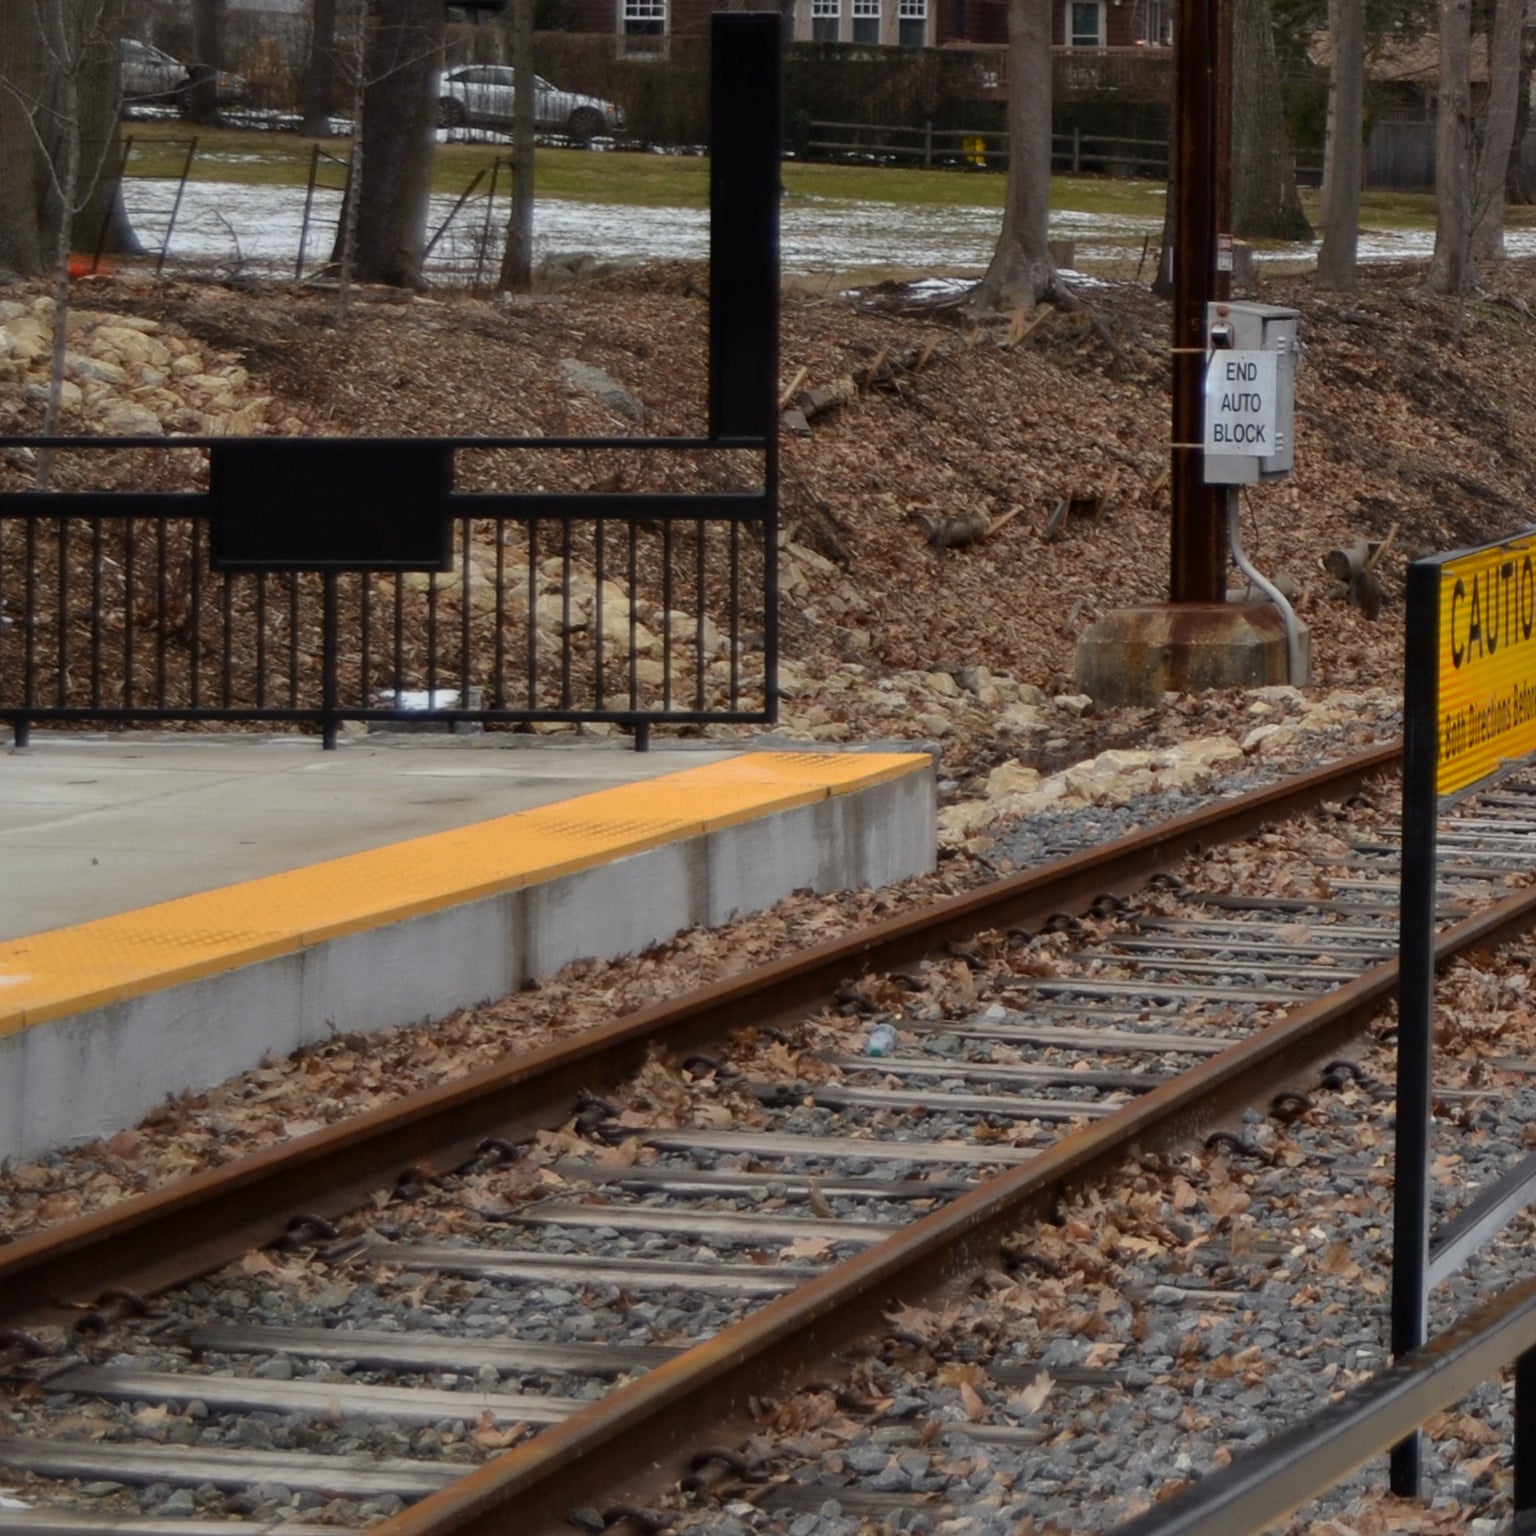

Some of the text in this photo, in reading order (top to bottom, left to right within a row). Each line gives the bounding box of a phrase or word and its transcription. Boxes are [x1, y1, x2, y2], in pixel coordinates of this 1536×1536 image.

[1226, 362, 1257, 381] END
[1221, 393, 1262, 413] AUTO
[1213, 423, 1266, 443] BLOCK
[1468, 693, 1511, 748] Directions
